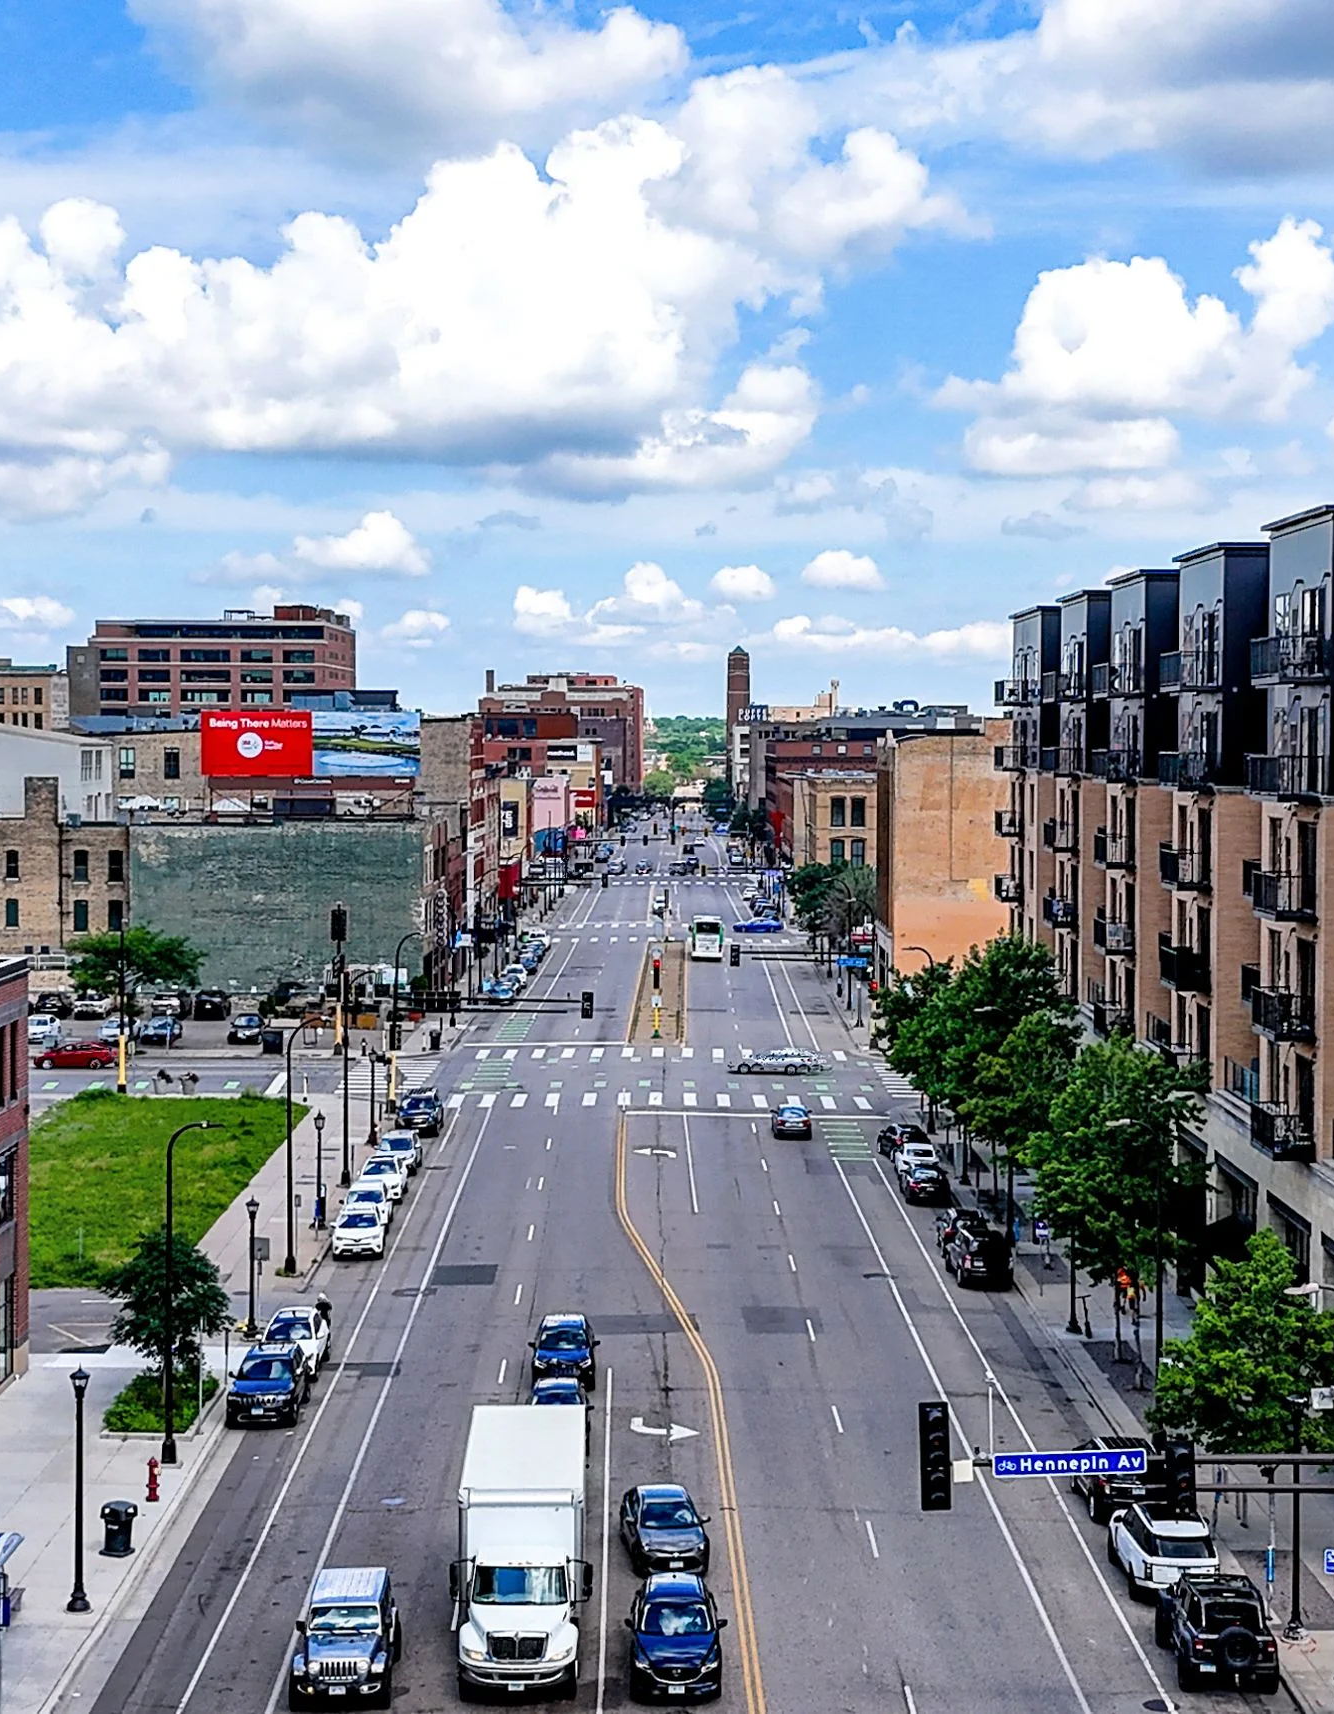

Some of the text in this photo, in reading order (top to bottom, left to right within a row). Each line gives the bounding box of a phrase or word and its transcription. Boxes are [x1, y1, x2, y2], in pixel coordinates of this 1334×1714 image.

[209, 718, 307, 730] Being There Matters
[1019, 1454, 1142, 1472] Hennepin Av
